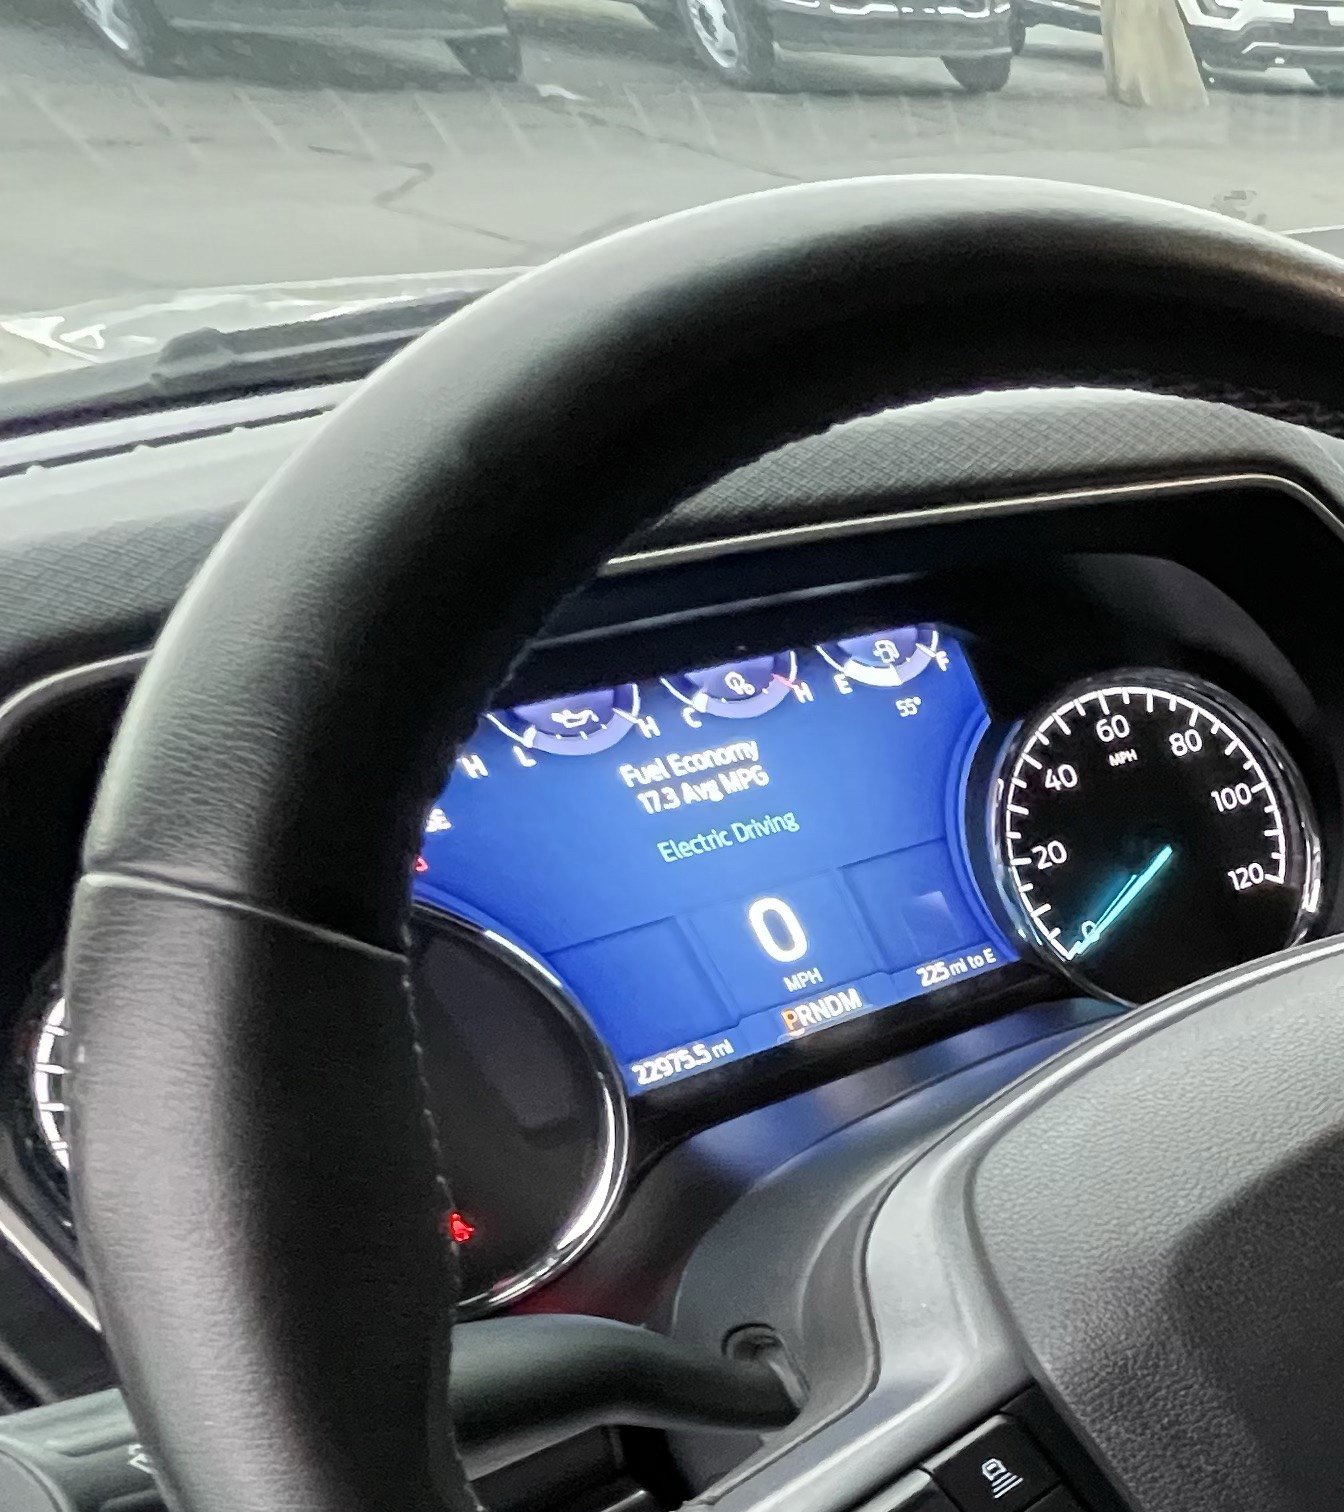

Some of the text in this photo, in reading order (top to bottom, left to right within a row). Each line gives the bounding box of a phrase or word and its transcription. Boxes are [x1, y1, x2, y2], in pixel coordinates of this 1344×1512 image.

[637, 716, 661, 738] H
[1096, 714, 1131, 743] 60
[513, 746, 537, 767] L
[1108, 749, 1138, 767] MPH
[1169, 729, 1203, 758] 80
[619, 741, 759, 788] Fuel Economy
[1044, 763, 1078, 792] 40
[681, 779, 724, 804] Avg
[718, 765, 770, 795] MPG
[1210, 782, 1252, 812] 100
[657, 812, 800, 863] Electric Driving
[1031, 840, 1068, 870] 20
[1227, 862, 1265, 891] 120
[749, 896, 809, 963] 0
[783, 967, 824, 993] MPH
[915, 948, 997, 988] 225 mi to E
[781, 989, 863, 1032] PRNDM
[711, 1038, 734, 1060] mi
